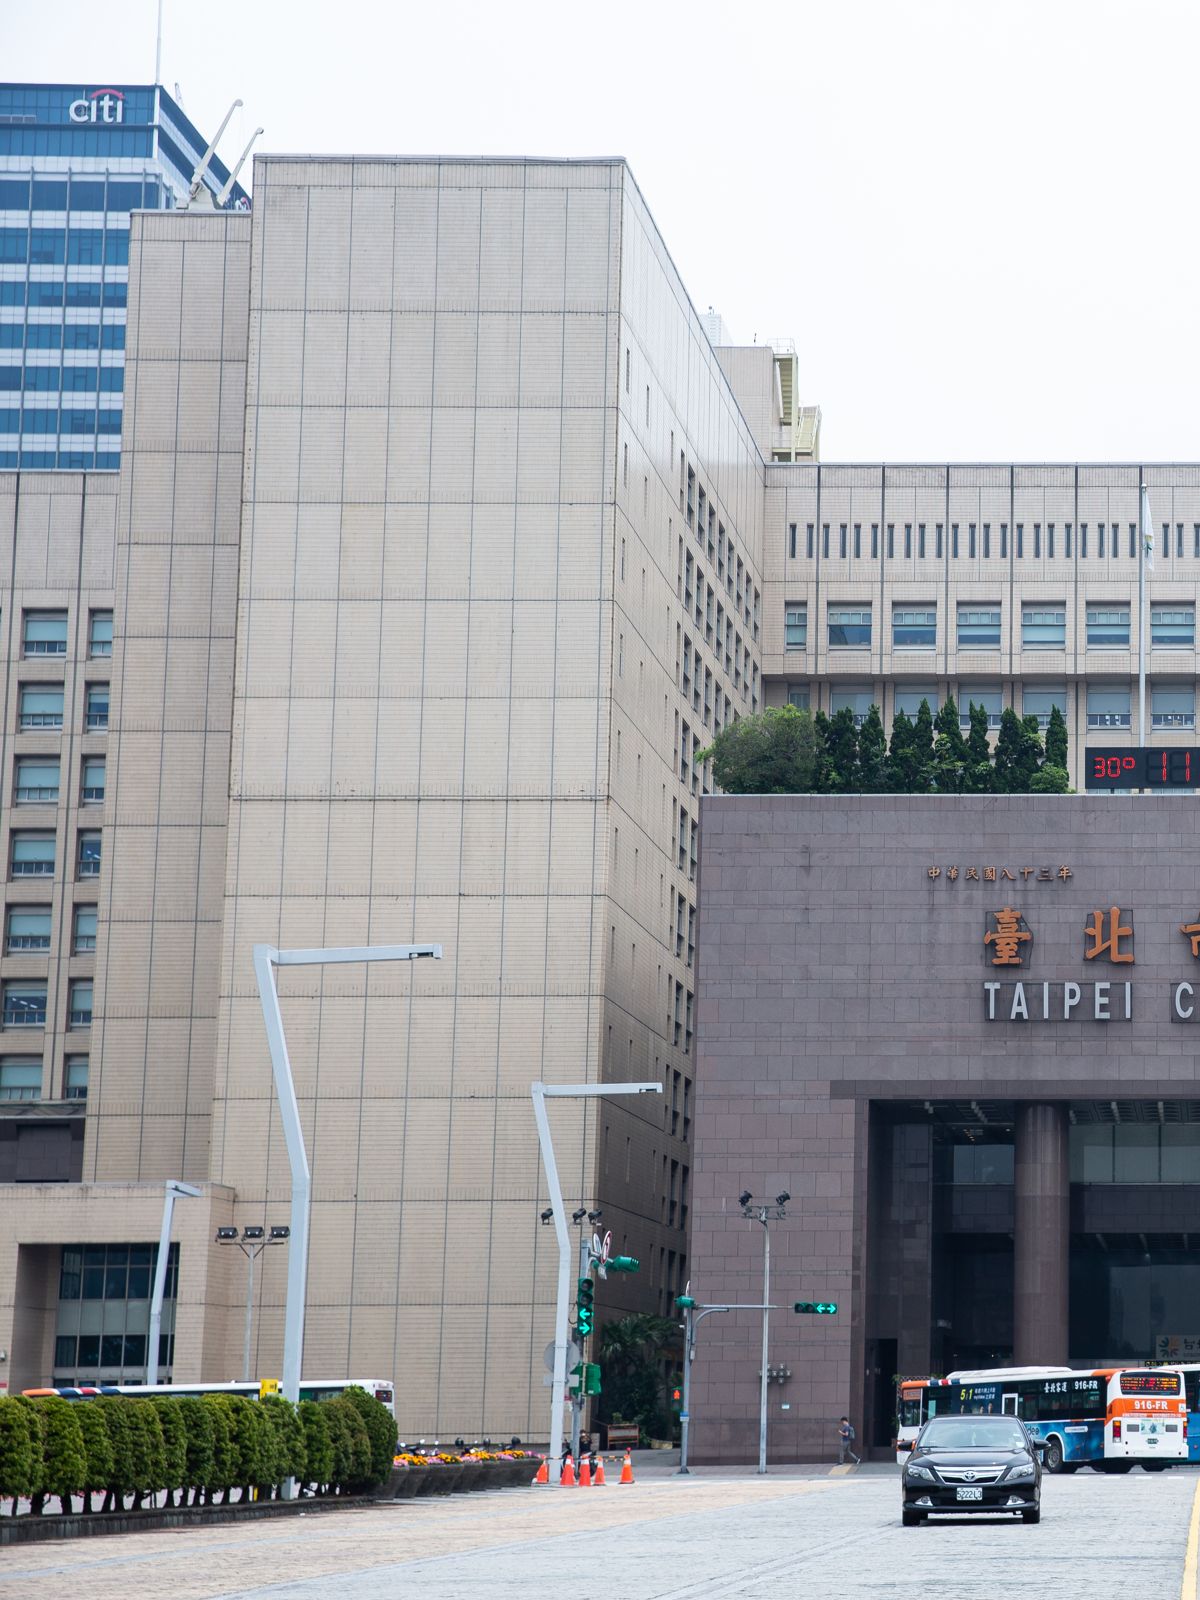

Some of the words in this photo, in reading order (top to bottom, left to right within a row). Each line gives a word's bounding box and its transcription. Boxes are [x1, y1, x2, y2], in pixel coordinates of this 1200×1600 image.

[69, 90, 124, 123] citi
[927, 864, 1073, 882] 中華民國八十三年
[983, 981, 1132, 1021] TAIPEI
[1074, 1380, 1098, 1390] 916-FR
[1134, 1400, 1168, 1410] 916-FR
